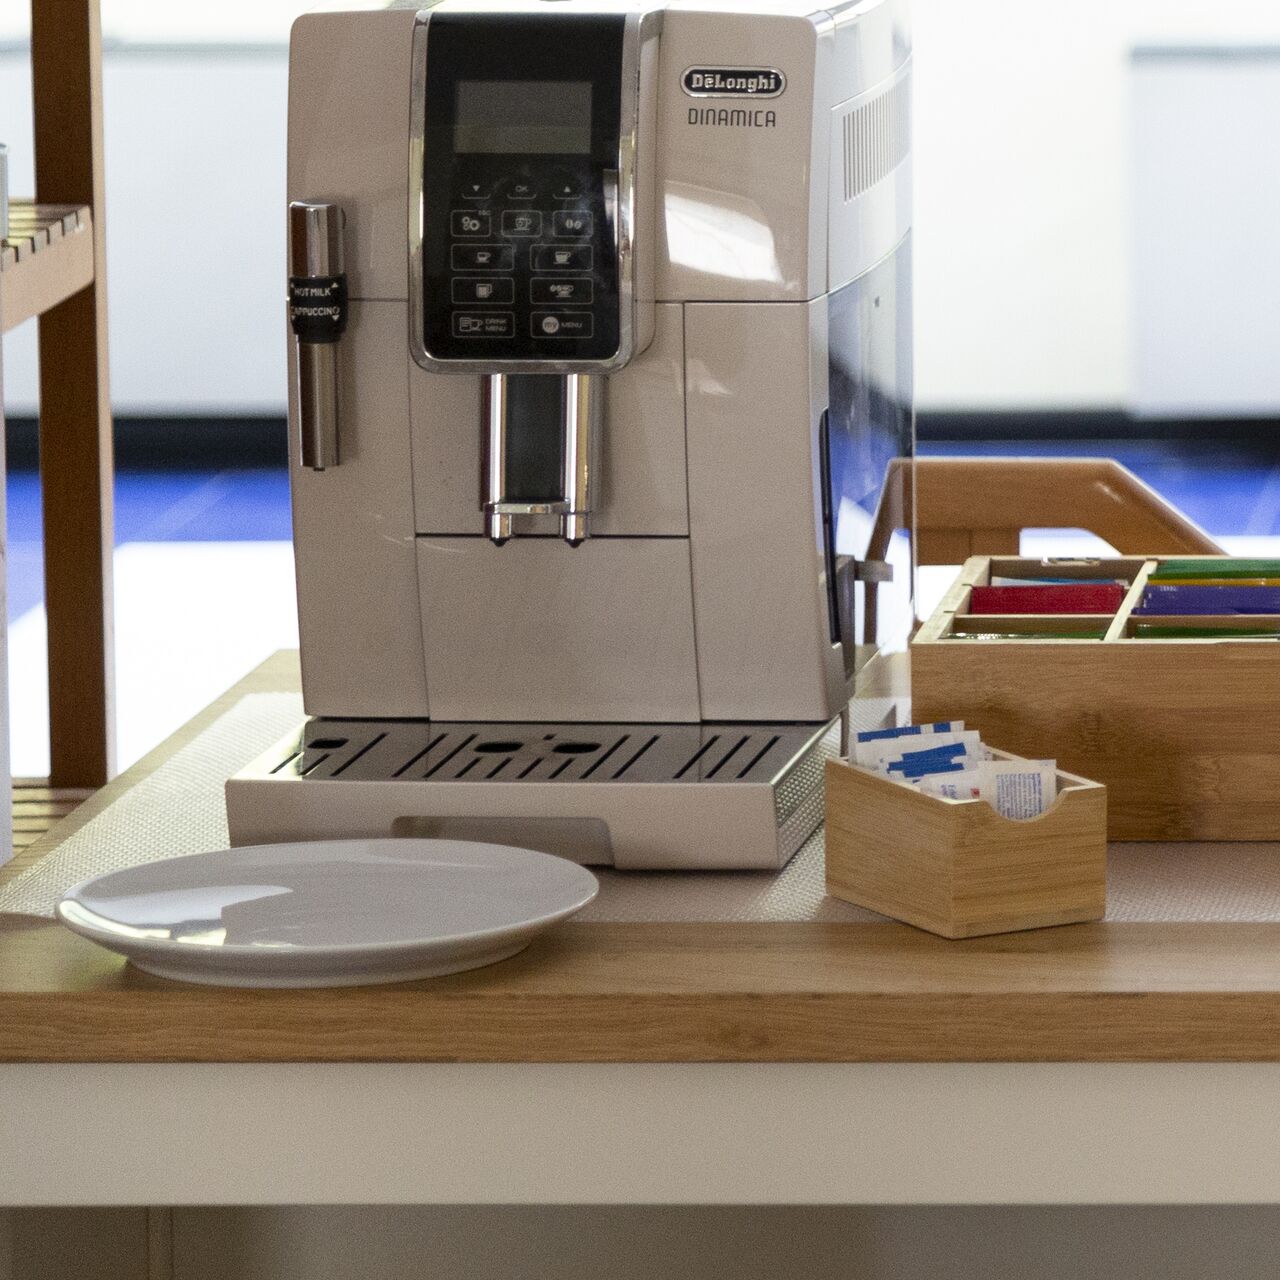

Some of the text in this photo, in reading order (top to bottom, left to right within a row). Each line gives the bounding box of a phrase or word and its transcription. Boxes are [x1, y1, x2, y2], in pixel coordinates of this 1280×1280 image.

[688, 108, 776, 128] DINAMICA
[294, 288, 331, 296] HOT MILK
